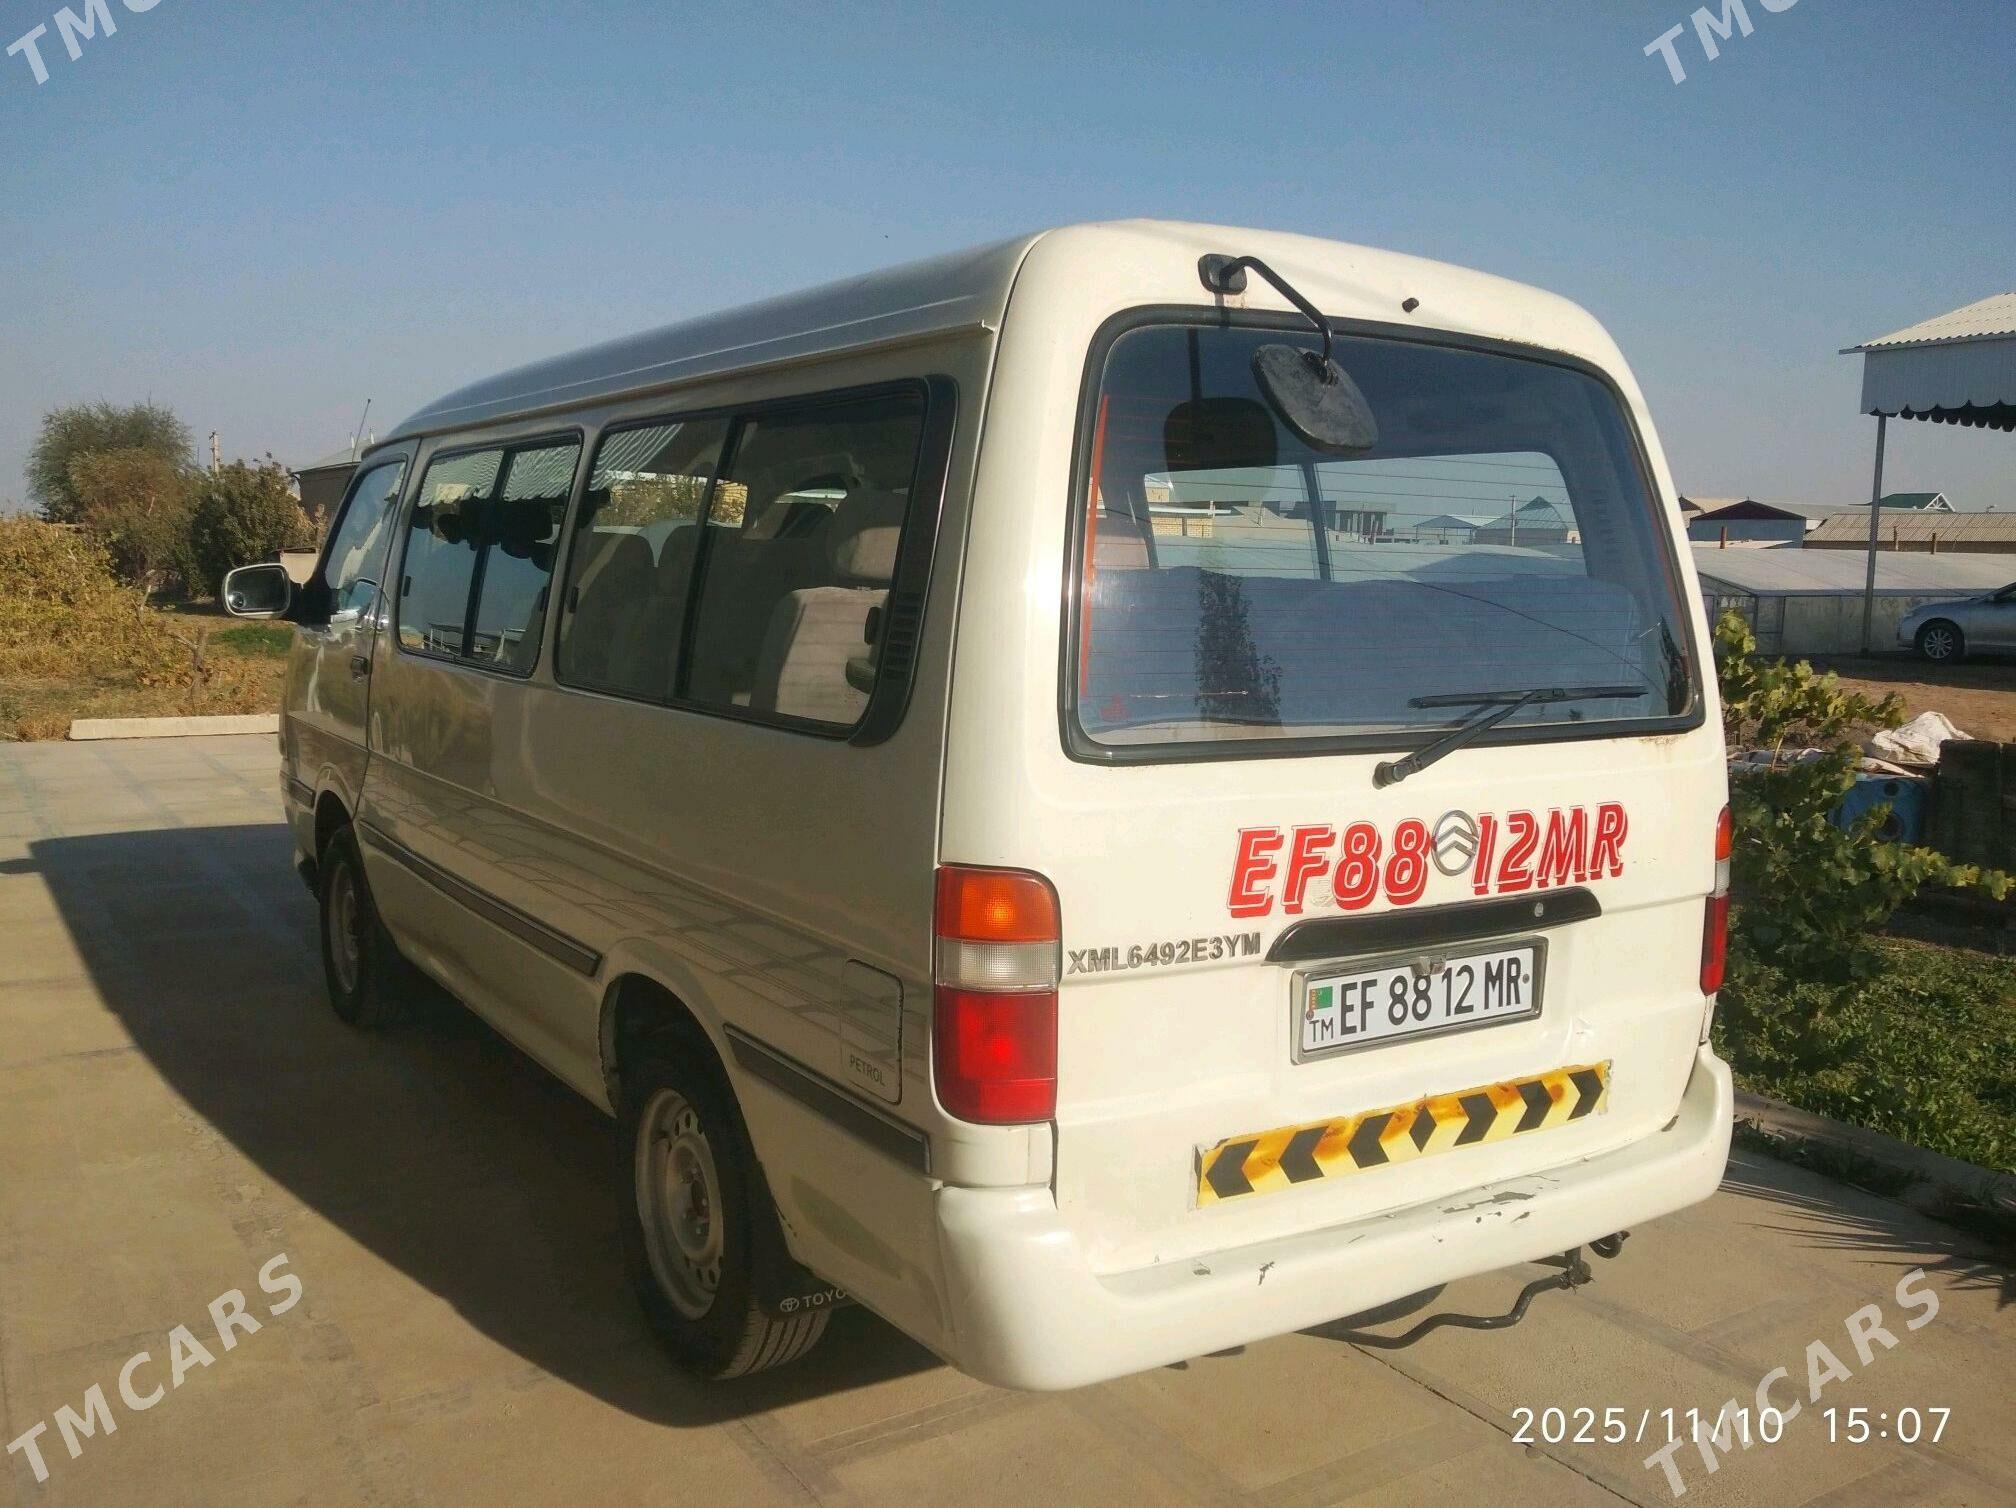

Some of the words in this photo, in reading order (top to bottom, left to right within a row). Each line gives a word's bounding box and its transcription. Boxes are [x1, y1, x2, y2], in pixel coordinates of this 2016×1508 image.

[1066, 932, 1261, 975] XML6492E3YM
[1340, 978, 1377, 1035] EF
[1387, 974, 1432, 1026] 88
[1441, 964, 1475, 1017] 12
[1483, 956, 1521, 1010] MR
[1308, 1016, 1334, 1043] TM
[849, 1053, 886, 1087] PETROL
